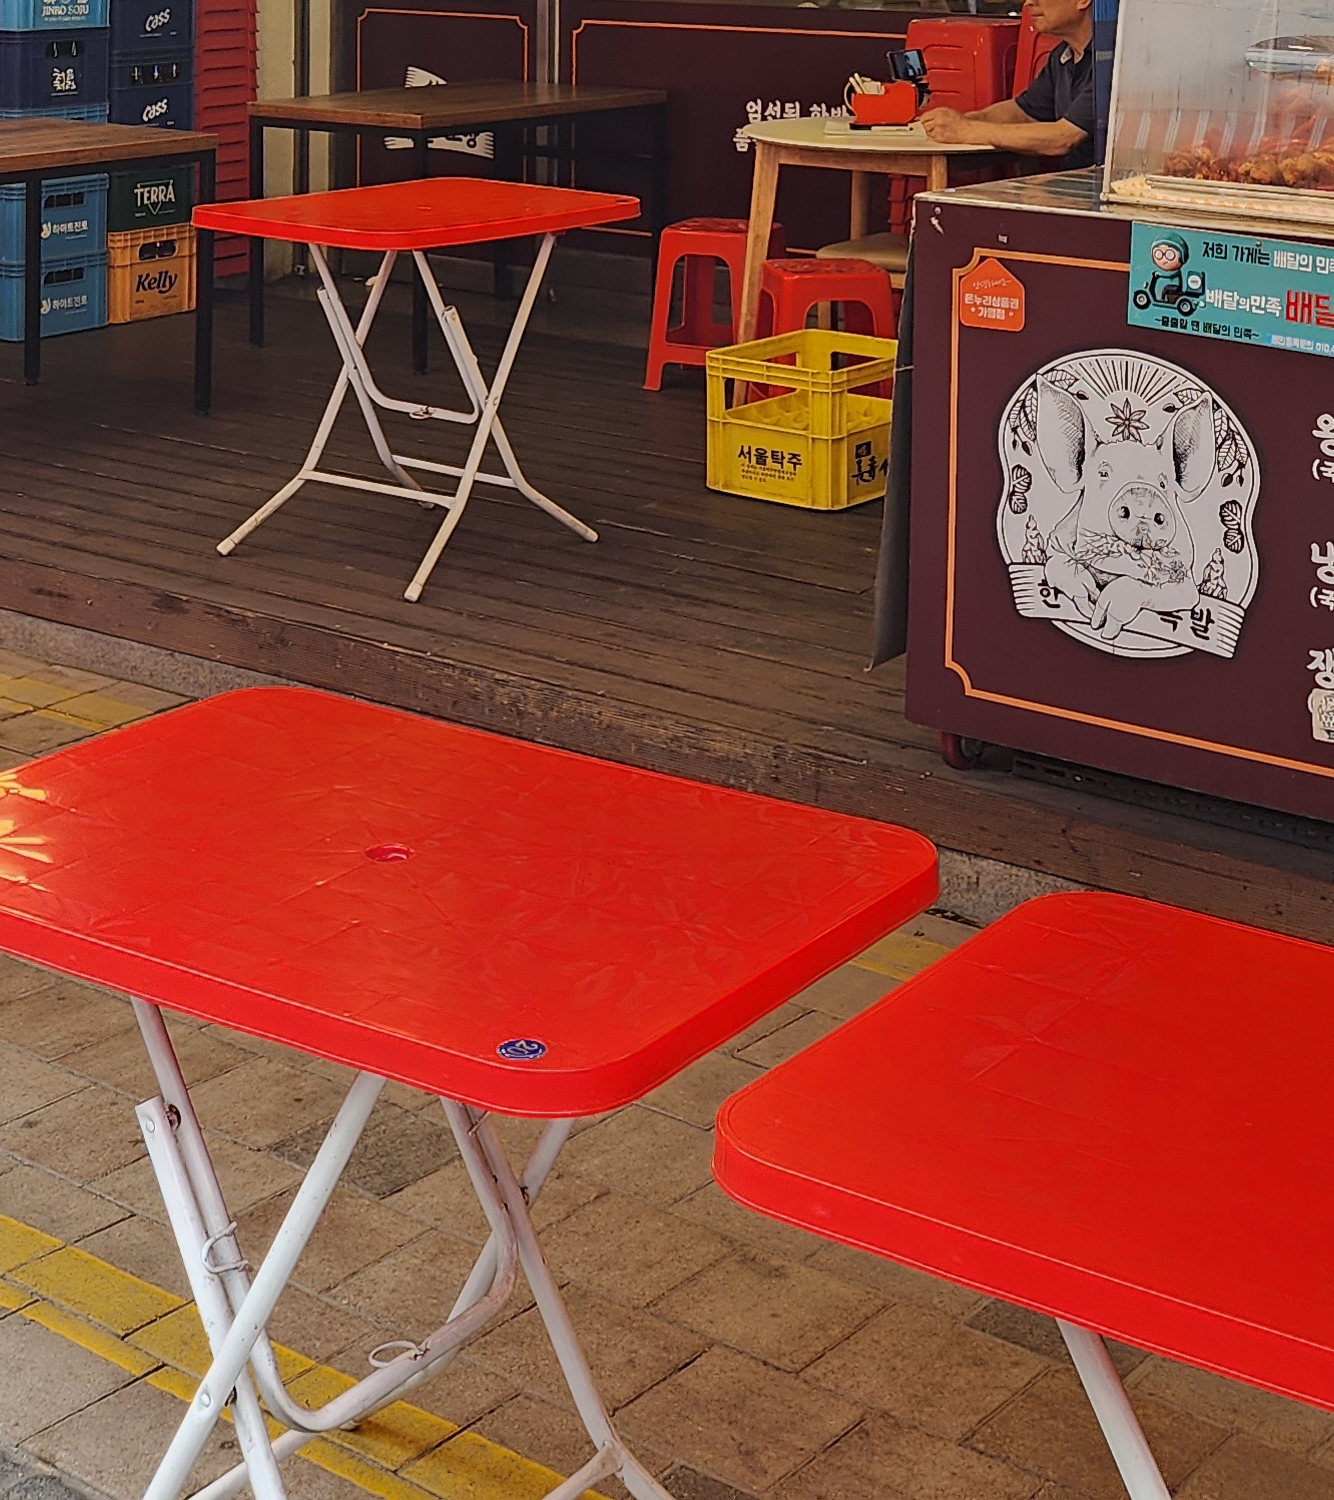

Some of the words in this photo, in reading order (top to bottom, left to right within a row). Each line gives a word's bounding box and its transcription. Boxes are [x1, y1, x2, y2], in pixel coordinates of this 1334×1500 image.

[133, 180, 176, 206] TERRA
[53, 219, 88, 236] 하이트진로
[1202, 241, 1228, 260] 저희
[1232, 245, 1271, 266] 가게는
[1273, 250, 1313, 273] 배달의
[135, 269, 179, 295] Kelly
[53, 294, 88, 310] 하이트진로
[1206, 289, 1282, 318] 배달의민족
[1203, 321, 1231, 336] 배달의
[738, 444, 803, 472] 서울탁주
